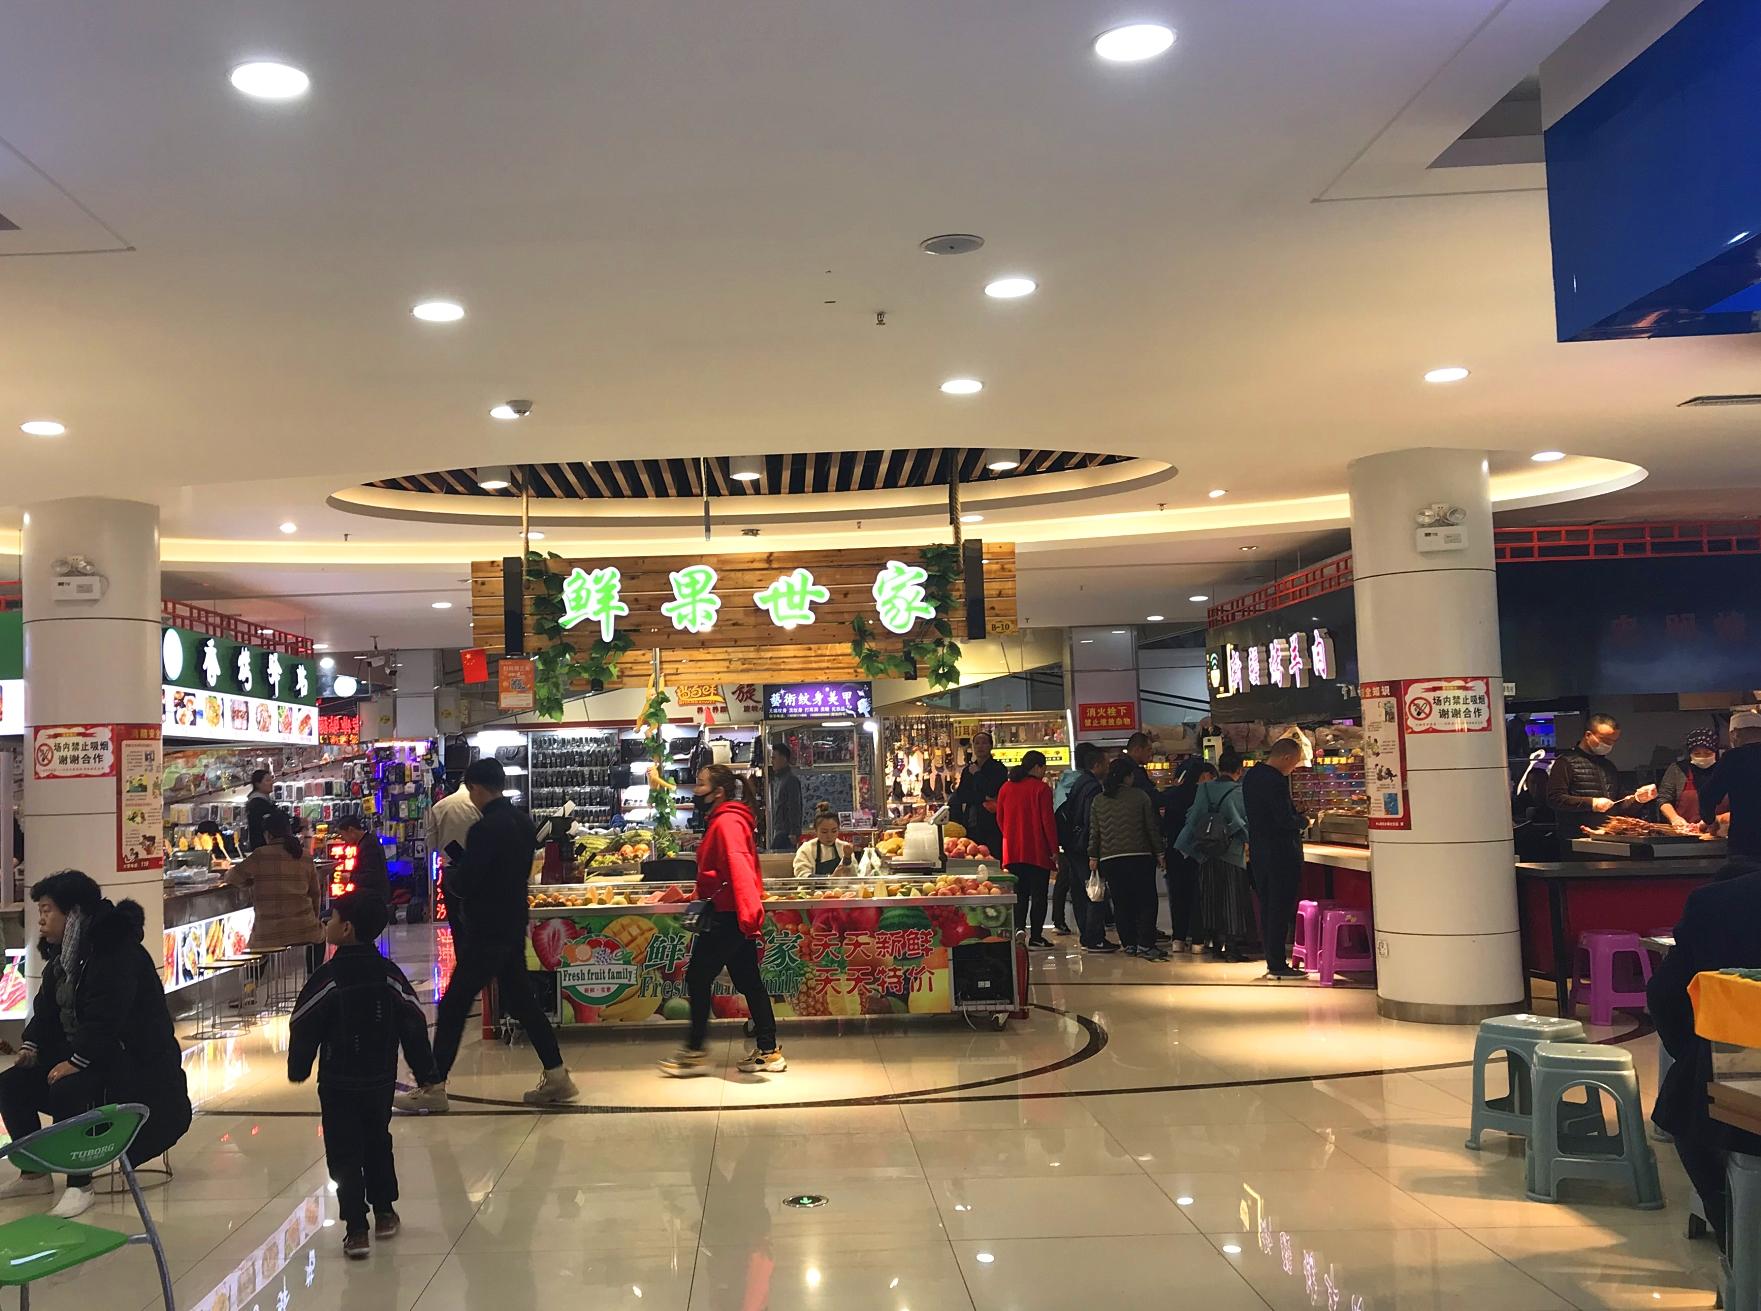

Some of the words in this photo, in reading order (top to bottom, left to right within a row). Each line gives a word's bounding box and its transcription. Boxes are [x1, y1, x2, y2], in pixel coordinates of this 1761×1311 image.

[558, 561, 936, 643] 鲜果世家
[991, 622, 1010, 632] B-10
[1432, 694, 1486, 706] 场内禁止吸烟
[1086, 706, 1128, 717] 消火栓下
[1438, 707, 1482, 720] 谢谢合作
[53, 741, 109, 752] 场内禁止吸烟
[58, 753, 104, 766] 谢谢合作
[642, 929, 805, 974] 鲜家
[811, 928, 936, 961] 天天新鲜
[562, 969, 586, 982] Fresh
[586, 968, 605, 981] fruit
[607, 967, 633, 983] family
[813, 963, 936, 996] 天天特价
[70, 1143, 115, 1160] TUBORG
